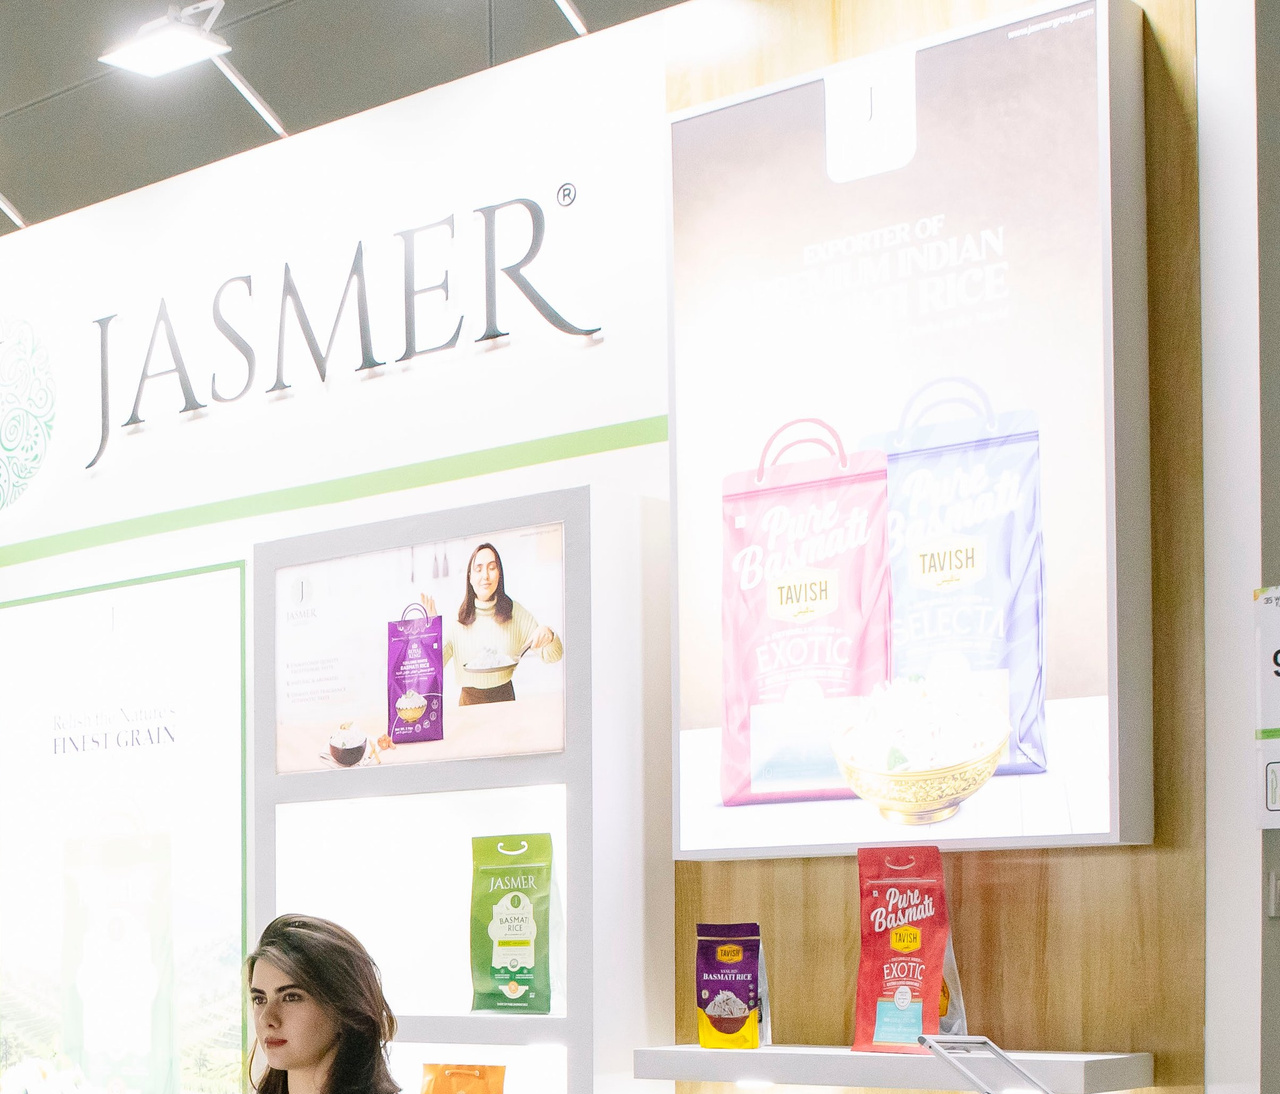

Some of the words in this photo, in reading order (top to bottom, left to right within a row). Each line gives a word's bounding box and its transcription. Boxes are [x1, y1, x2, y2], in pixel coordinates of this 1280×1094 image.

[803, 223, 910, 266] EXPORTER
[914, 214, 945, 239] OF
[896, 226, 1005, 278] INDIAN
[918, 261, 1010, 315] RICE
[904, 464, 990, 518] Pure
[761, 498, 840, 551] Pure
[732, 509, 872, 592] Basmati
[919, 547, 975, 574] TAVISH
[777, 580, 828, 606] TAVISH
[756, 636, 852, 673] EXOTIC
[53, 731, 112, 755] FINEST
[116, 726, 175, 748] GRAIN
[488, 875, 538, 893] JASMER
[886, 887, 921, 912] Pure
[499, 916, 530, 925] BASMATI
[507, 924, 523, 932] RICE
[870, 896, 935, 933] Basmati
[894, 932, 918, 944] TAVISH
[720, 949, 740, 957] TAVISH
[883, 962, 926, 980] EXOTIC
